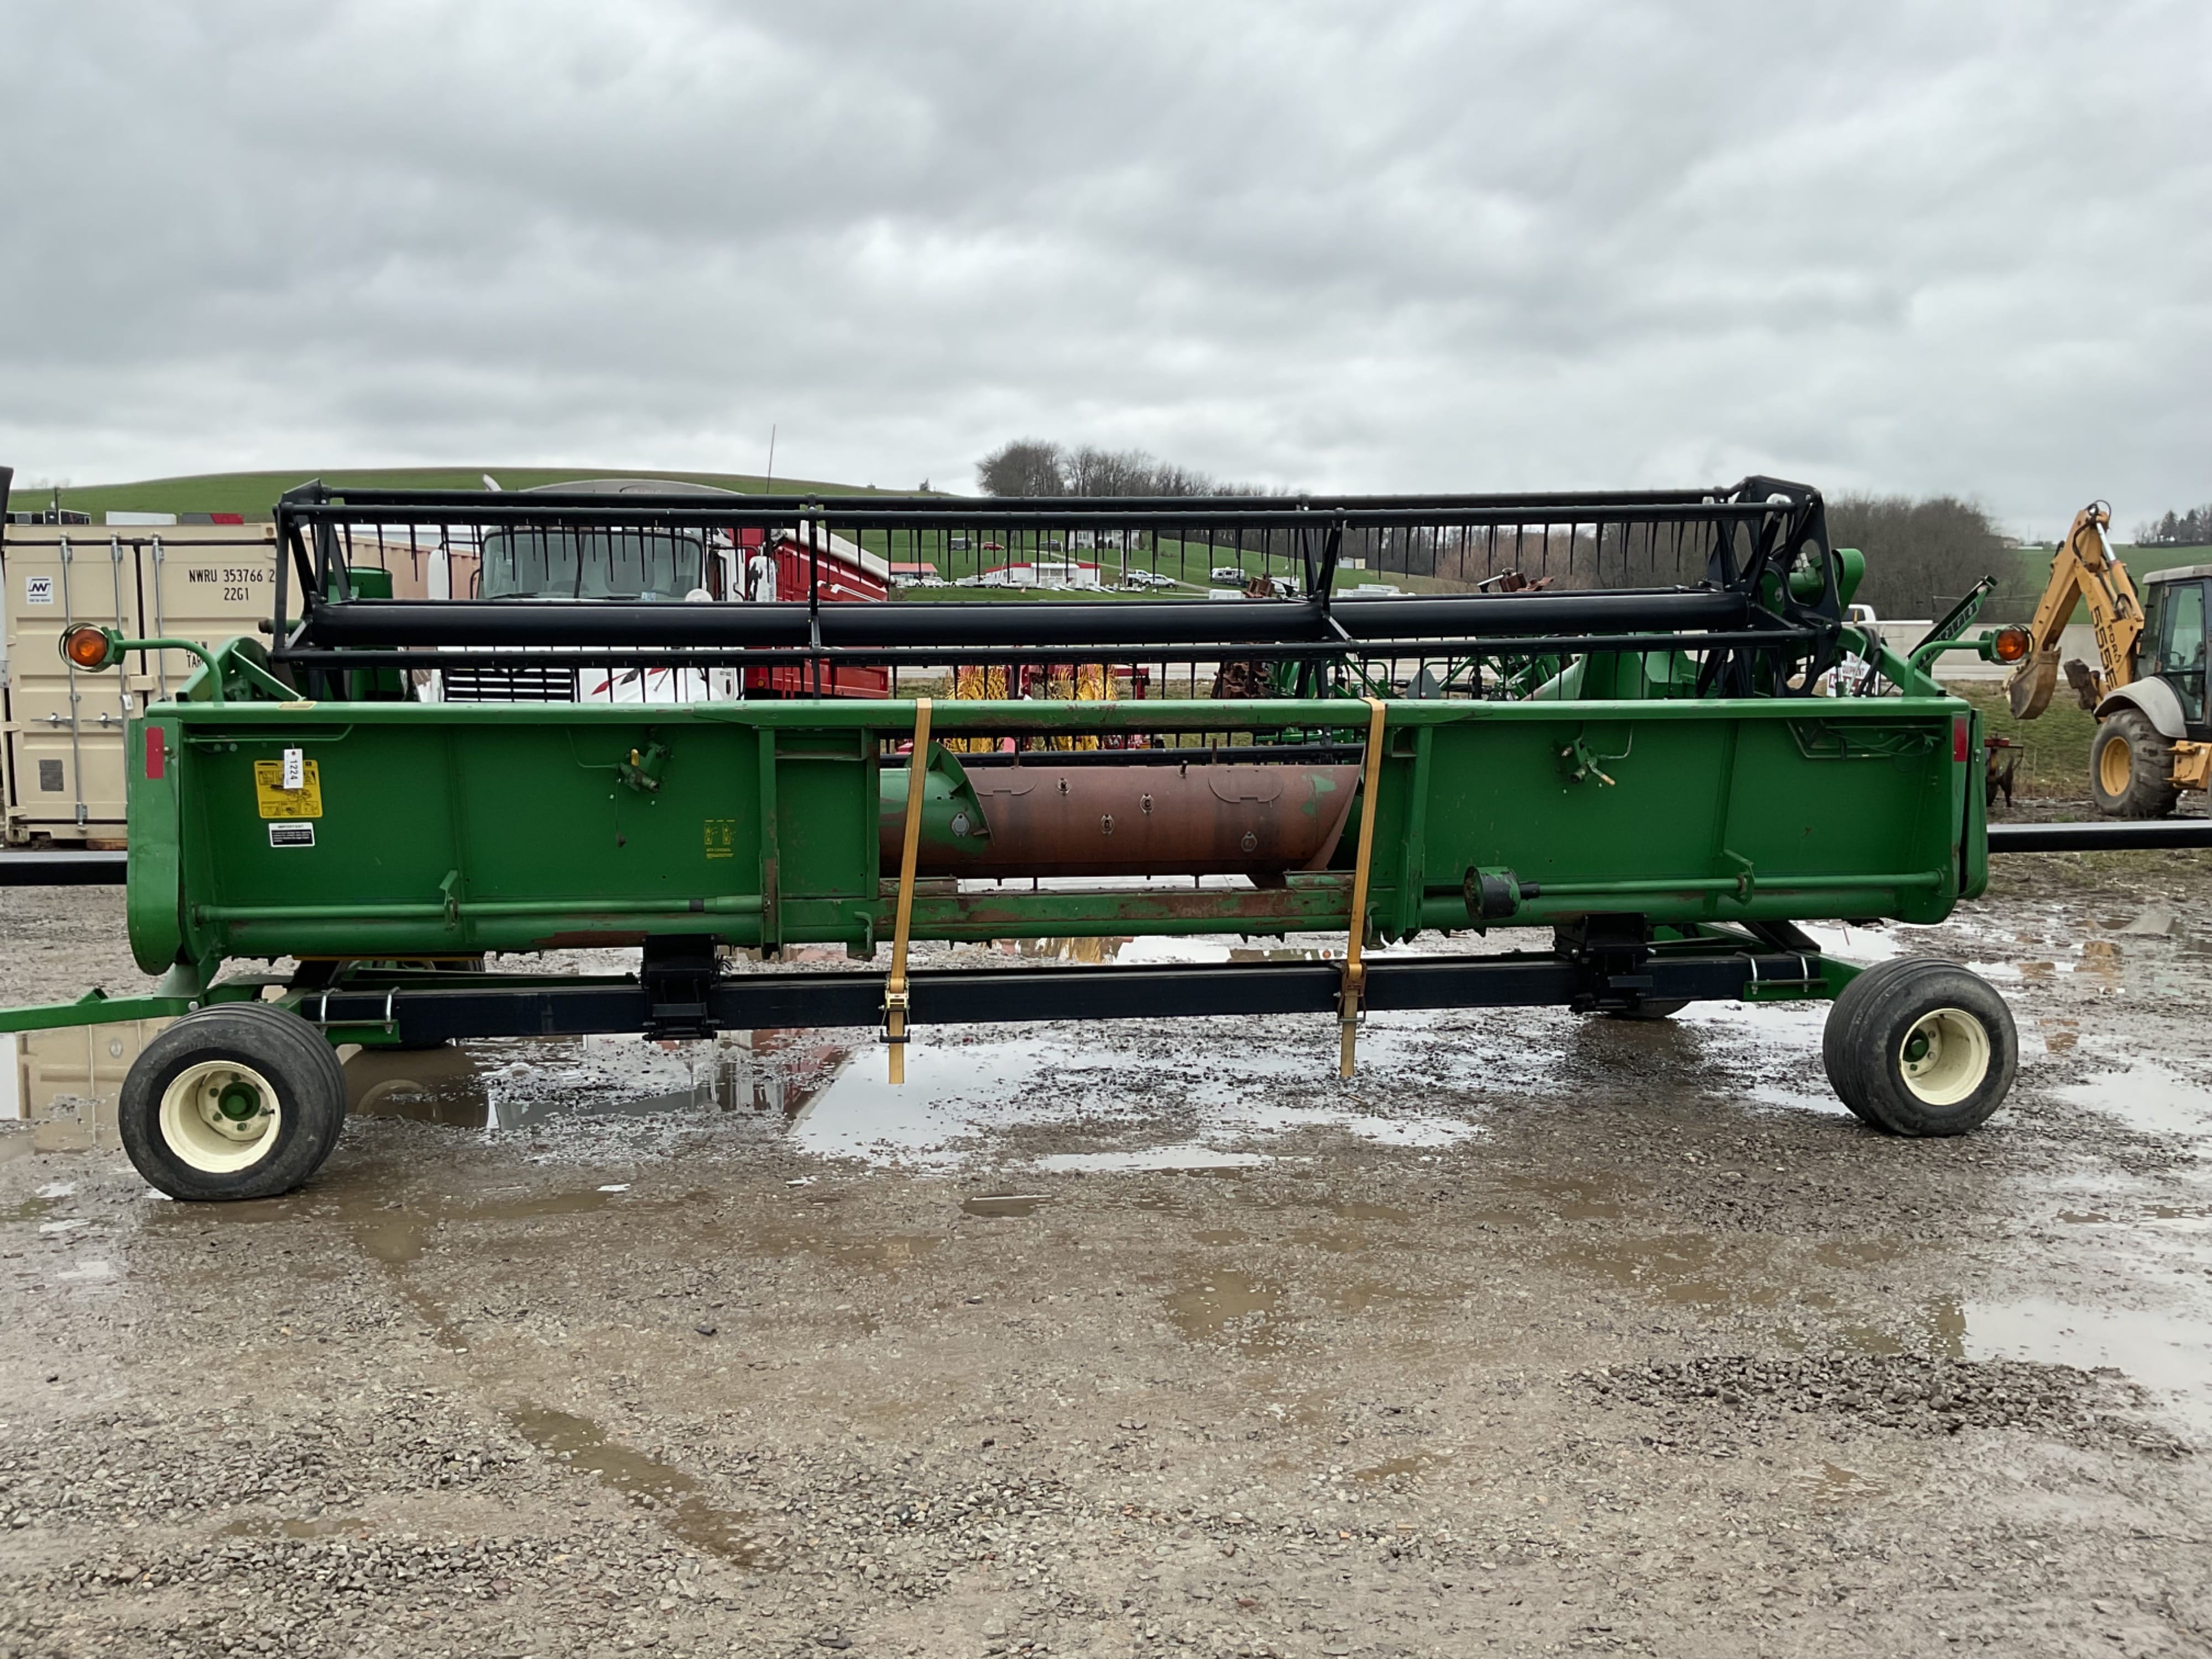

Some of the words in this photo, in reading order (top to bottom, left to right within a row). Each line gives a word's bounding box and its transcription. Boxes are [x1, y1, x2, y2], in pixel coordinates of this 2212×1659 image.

[189, 569, 217, 582] NWRU
[223, 569, 263, 582] 353766
[269, 569, 275, 582] 2
[224, 588, 249, 601] 22G1
[2091, 606, 2117, 691] 555E
[2107, 624, 2121, 663] FORD
[290, 760, 298, 780] 1224
